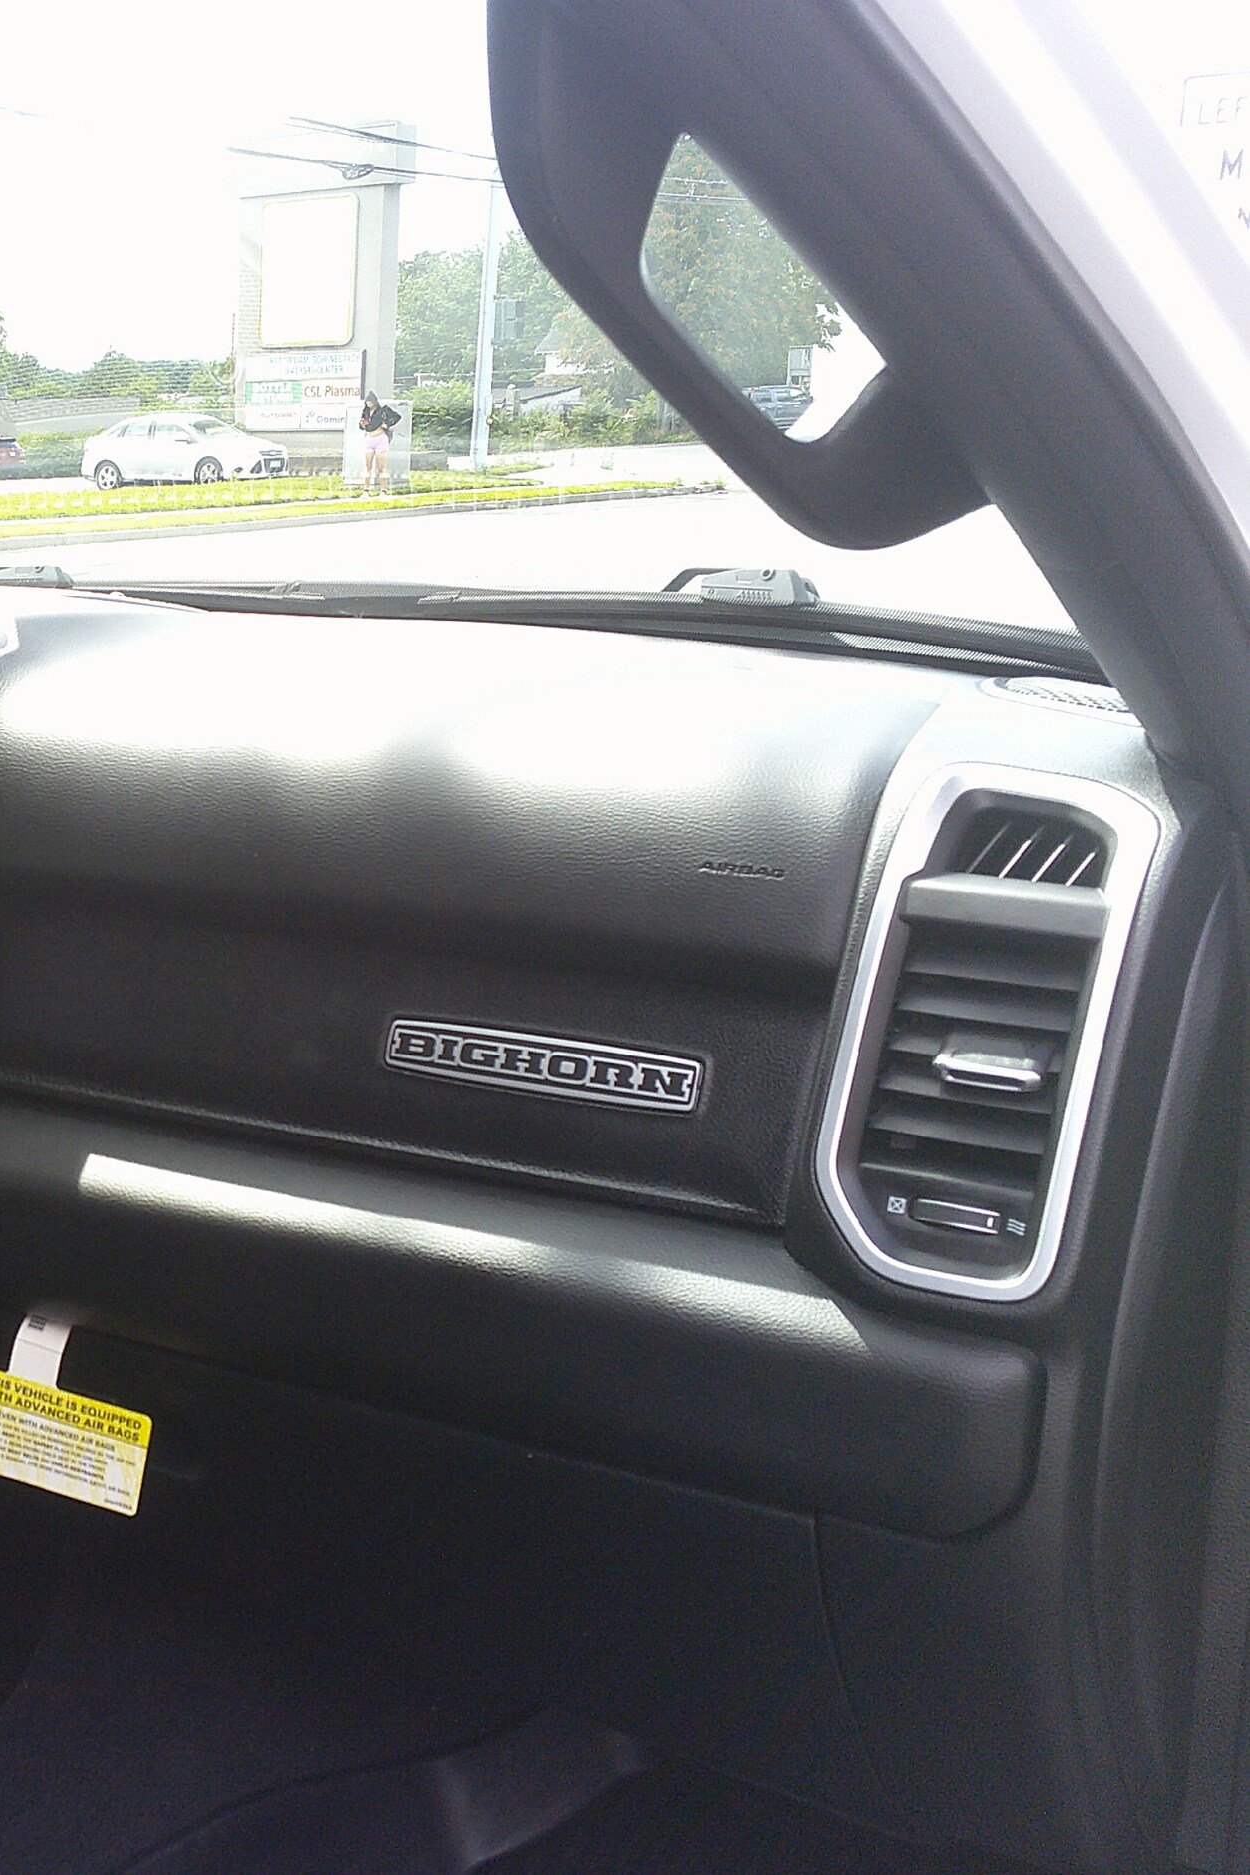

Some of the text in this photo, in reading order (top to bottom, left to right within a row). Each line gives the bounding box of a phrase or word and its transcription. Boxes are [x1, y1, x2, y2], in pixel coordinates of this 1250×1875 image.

[1198, 96, 1248, 125] LEF
[304, 385, 361, 398] CSL Plasma
[391, 1029, 695, 1101] BIGHORN
[14, 1382, 64, 1408] VEHICLE
[66, 1398, 77, 1411] IS
[80, 1402, 141, 1430] EQUIPPED
[15, 1397, 81, 1424] ADVANCED
[84, 1415, 104, 1431] AIR
[107, 1422, 139, 1442] BAGS
[39, 1421, 80, 1441] ADVANCED
